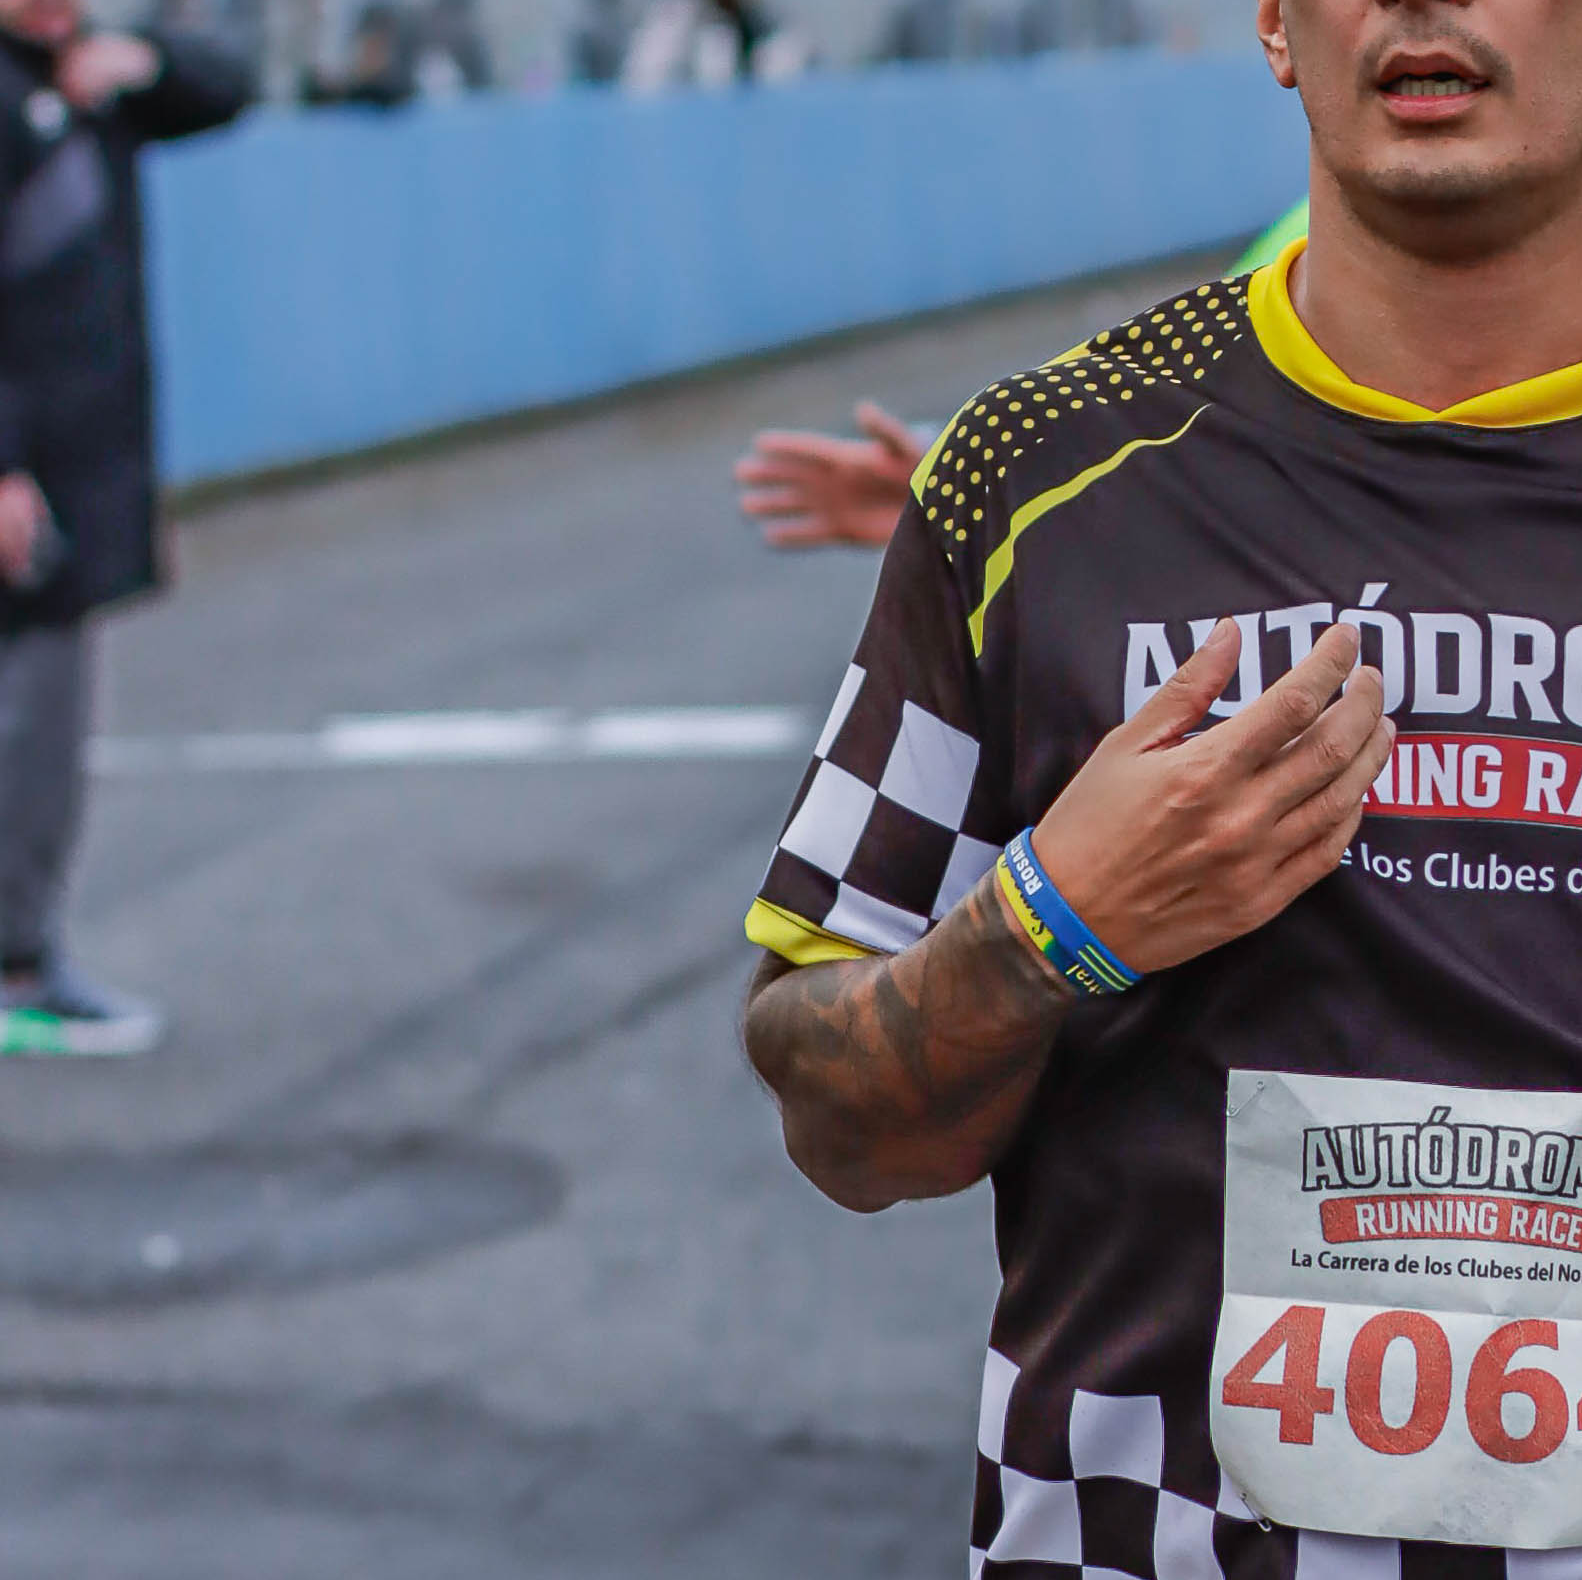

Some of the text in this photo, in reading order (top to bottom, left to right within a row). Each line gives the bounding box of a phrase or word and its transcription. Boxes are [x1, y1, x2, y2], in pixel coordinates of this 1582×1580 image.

[1360, 842, 1412, 883] los
[1423, 851, 1556, 893] Clubes
[1354, 1199, 1499, 1238] RUNNING
[1291, 1248, 1313, 1269] La
[1317, 1250, 1389, 1272] Carrera
[1394, 1254, 1420, 1274] de
[1424, 1255, 1452, 1276] los
[1457, 1258, 1523, 1280] Clubes
[1527, 1261, 1554, 1282] del
